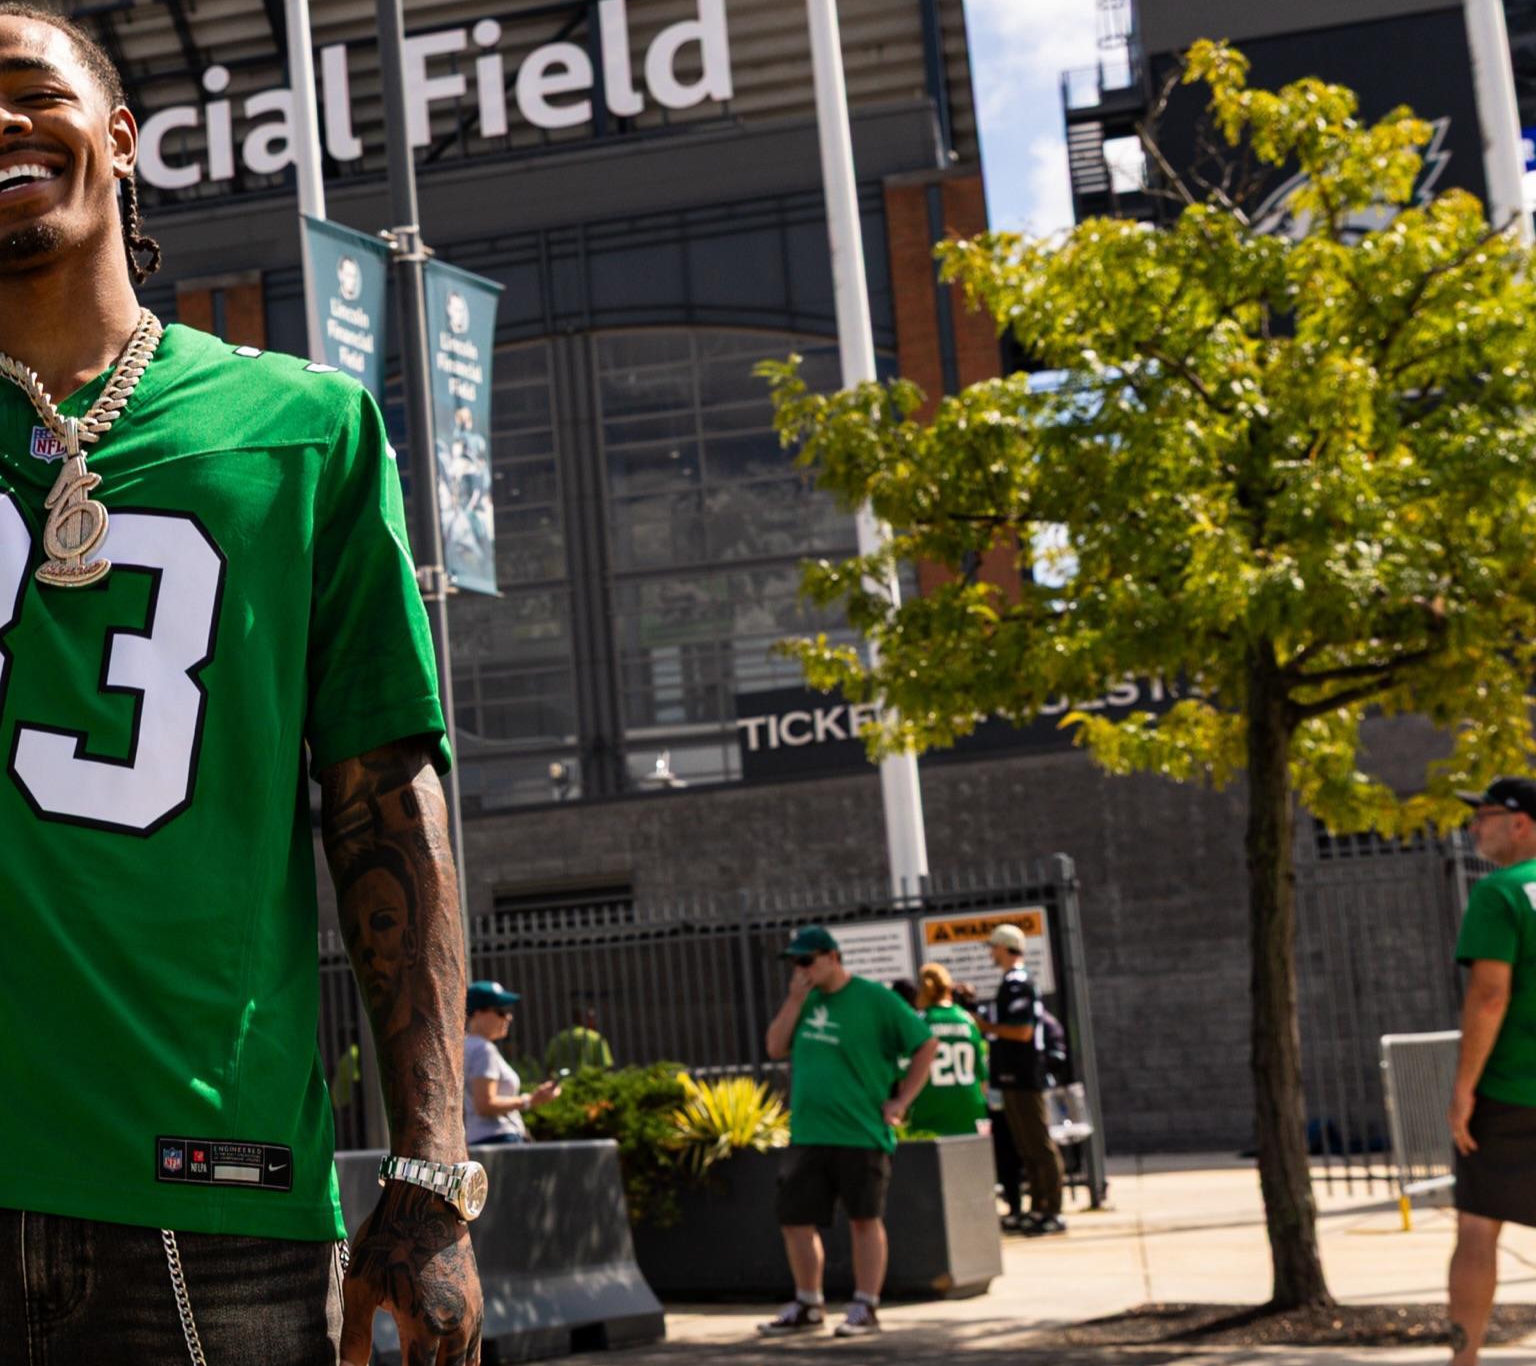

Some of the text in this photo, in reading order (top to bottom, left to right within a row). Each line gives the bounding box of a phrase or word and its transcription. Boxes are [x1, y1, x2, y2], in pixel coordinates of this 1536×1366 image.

[138, 44, 362, 190] cial
[37, 439, 66, 454] NFL
[737, 703, 878, 751] TICKE
[930, 1042, 976, 1086] 20
